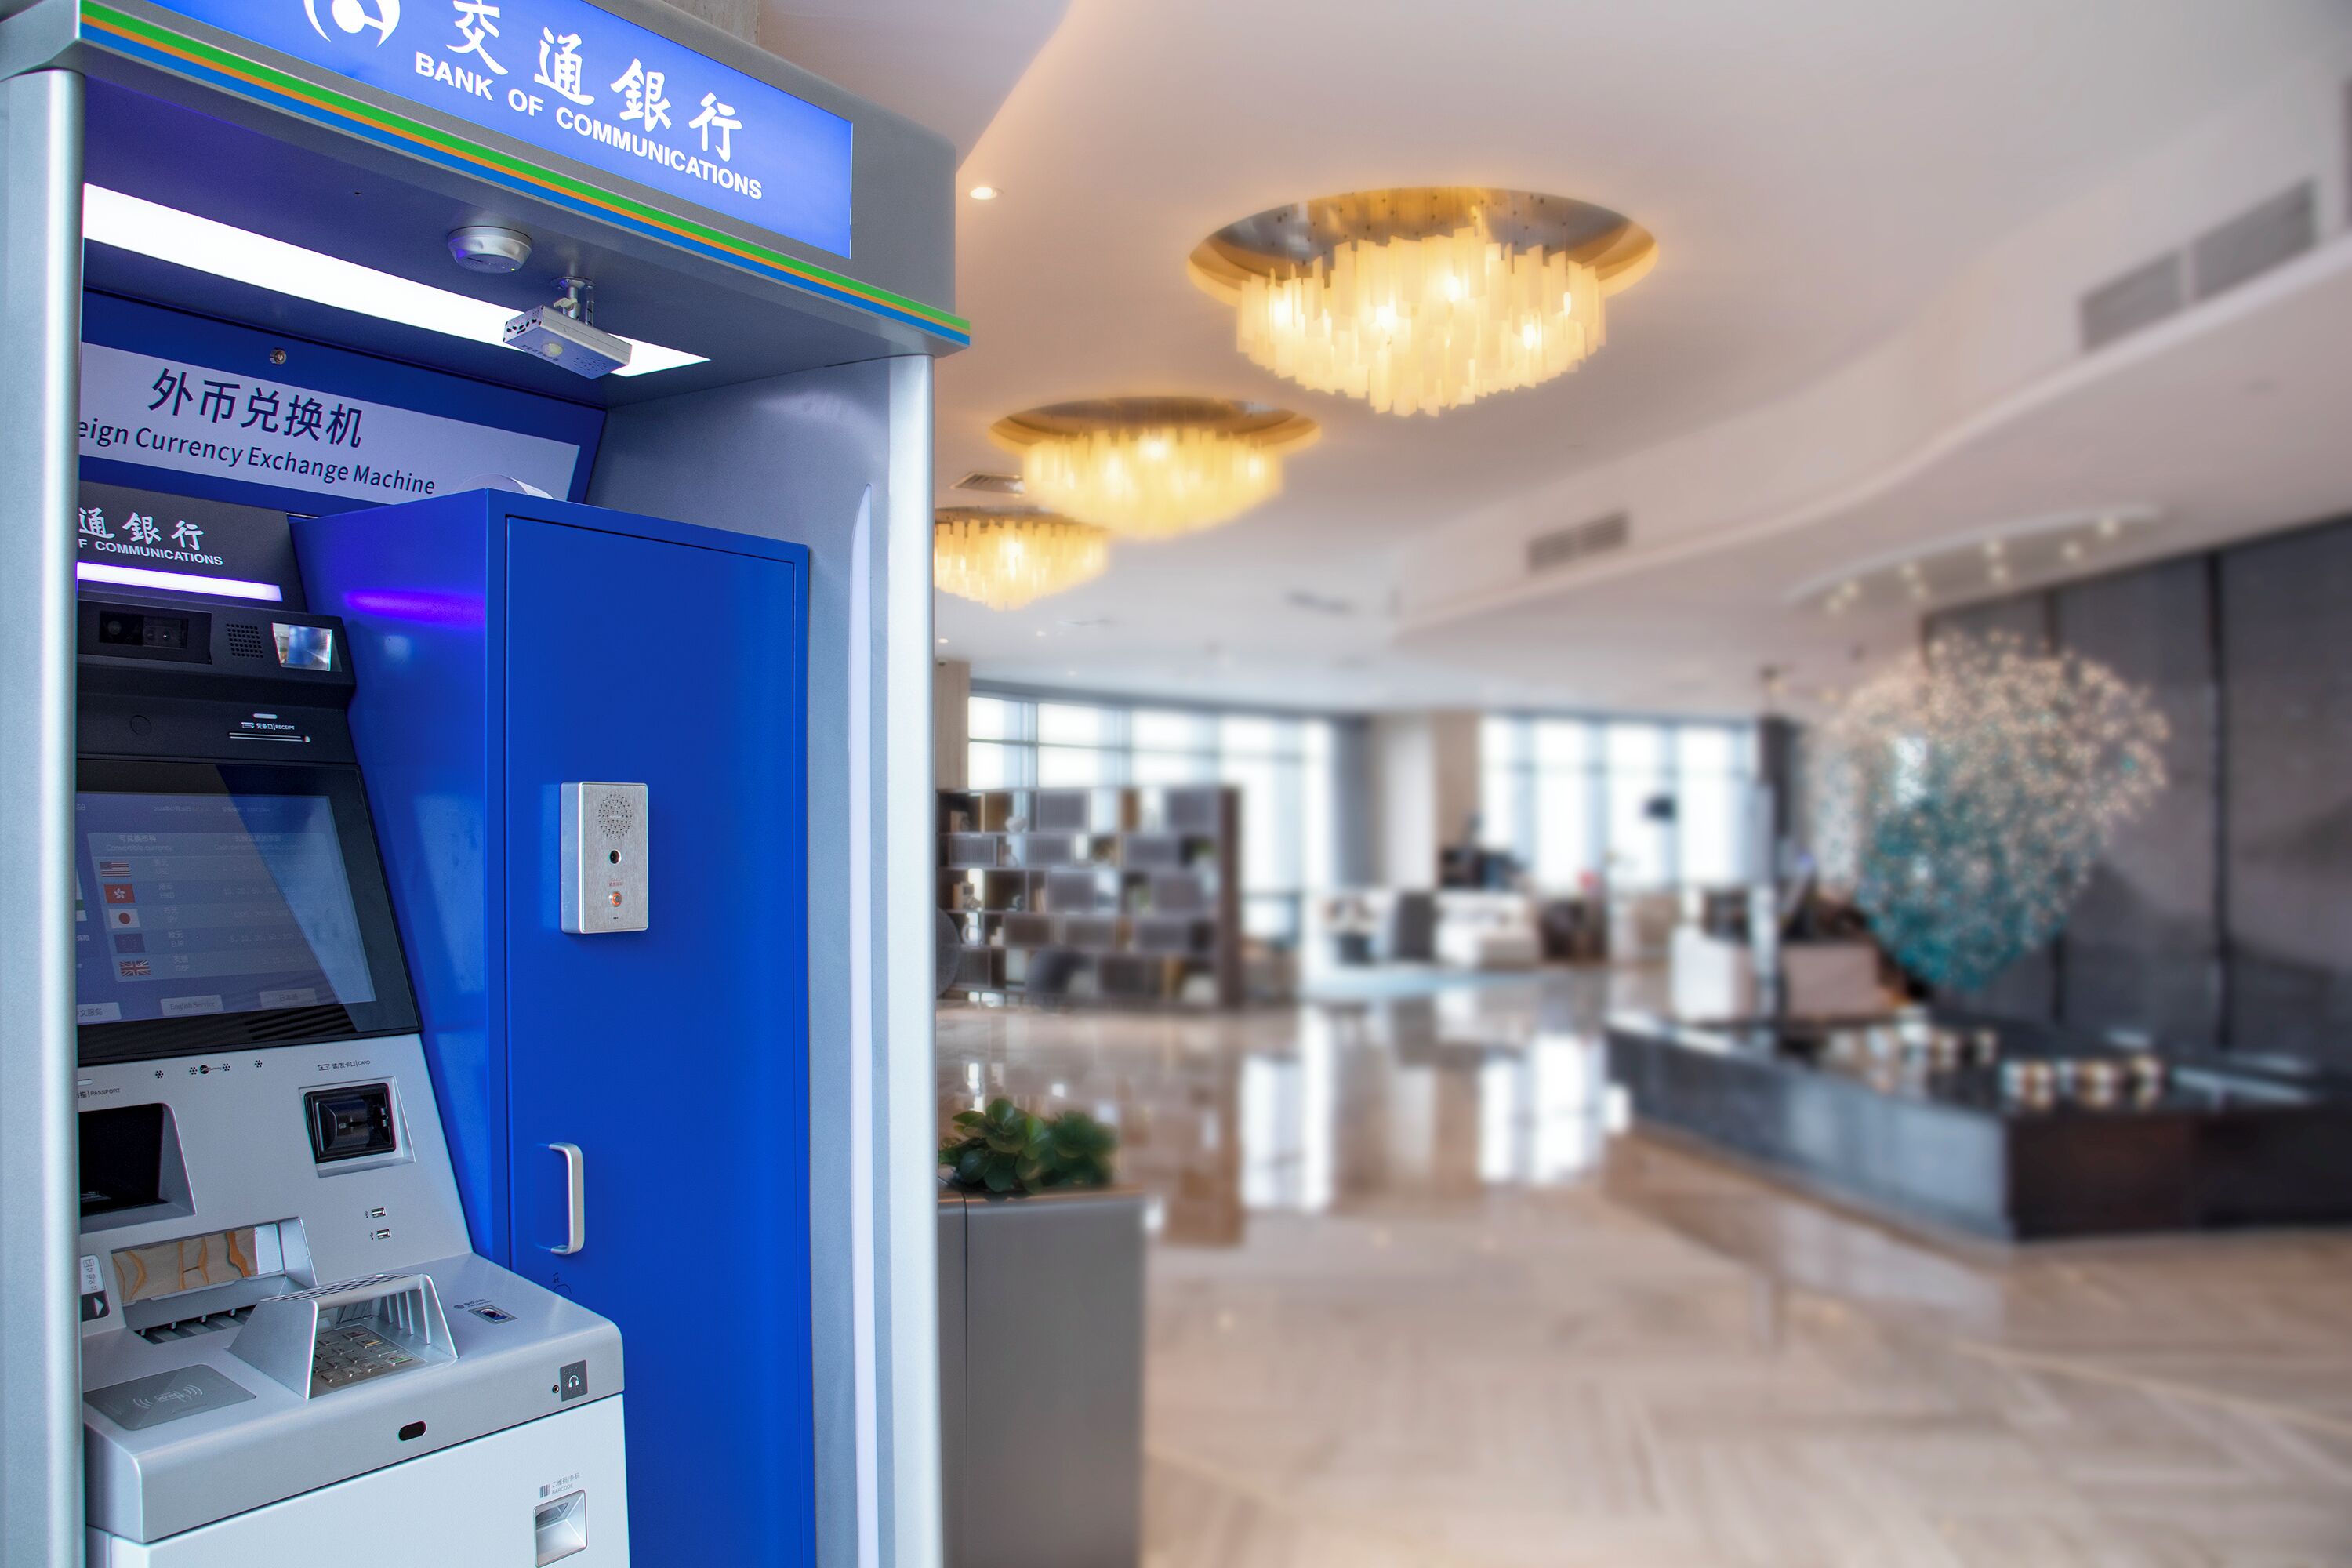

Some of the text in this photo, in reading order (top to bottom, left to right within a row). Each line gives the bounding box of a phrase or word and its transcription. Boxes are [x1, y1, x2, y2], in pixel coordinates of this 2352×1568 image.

[445, 0, 743, 162] 交通銀行
[415, 52, 763, 200] BANK OF COMMUNICATIONS
[147, 368, 363, 448] 外币兑换机
[79, 418, 436, 495] eign Currency Exchange Machine
[78, 507, 205, 551] 通銀行
[94, 540, 223, 565] COMMUNICATIONS
[170, 1003, 192, 1011] English
[89, 1087, 120, 1096] PASSPORT
[552, 1483, 573, 1495] BARCODE
